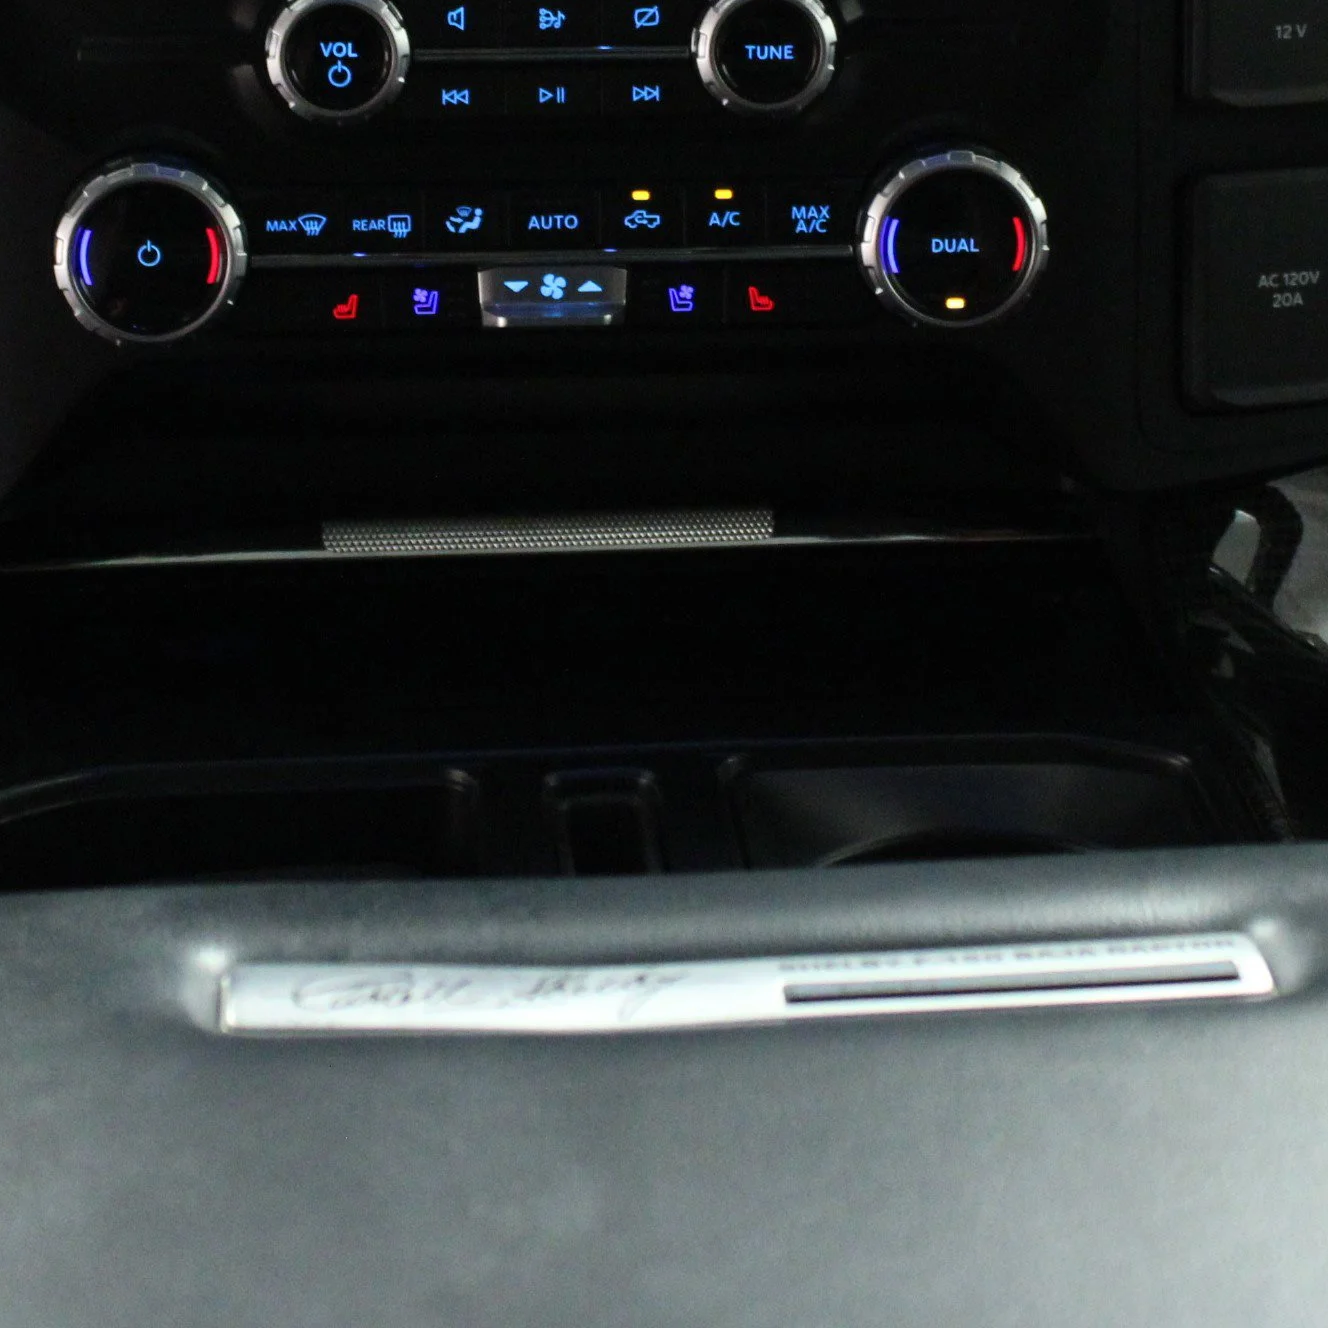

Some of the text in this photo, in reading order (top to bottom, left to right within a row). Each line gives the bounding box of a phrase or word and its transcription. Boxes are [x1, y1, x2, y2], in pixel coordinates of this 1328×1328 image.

[1275, 24, 1307, 39] 12 V
[321, 42, 357, 58] VOL
[745, 45, 794, 60] TUNE
[709, 212, 740, 226] A/C
[792, 206, 829, 219] MAX
[266, 220, 297, 231] MAX
[353, 219, 386, 231] REAR
[528, 215, 578, 229] AUTO
[796, 220, 826, 233] A/C
[932, 239, 979, 253] DUAL
[1259, 271, 1320, 288] AC 120V
[1273, 292, 1303, 308] 20A
